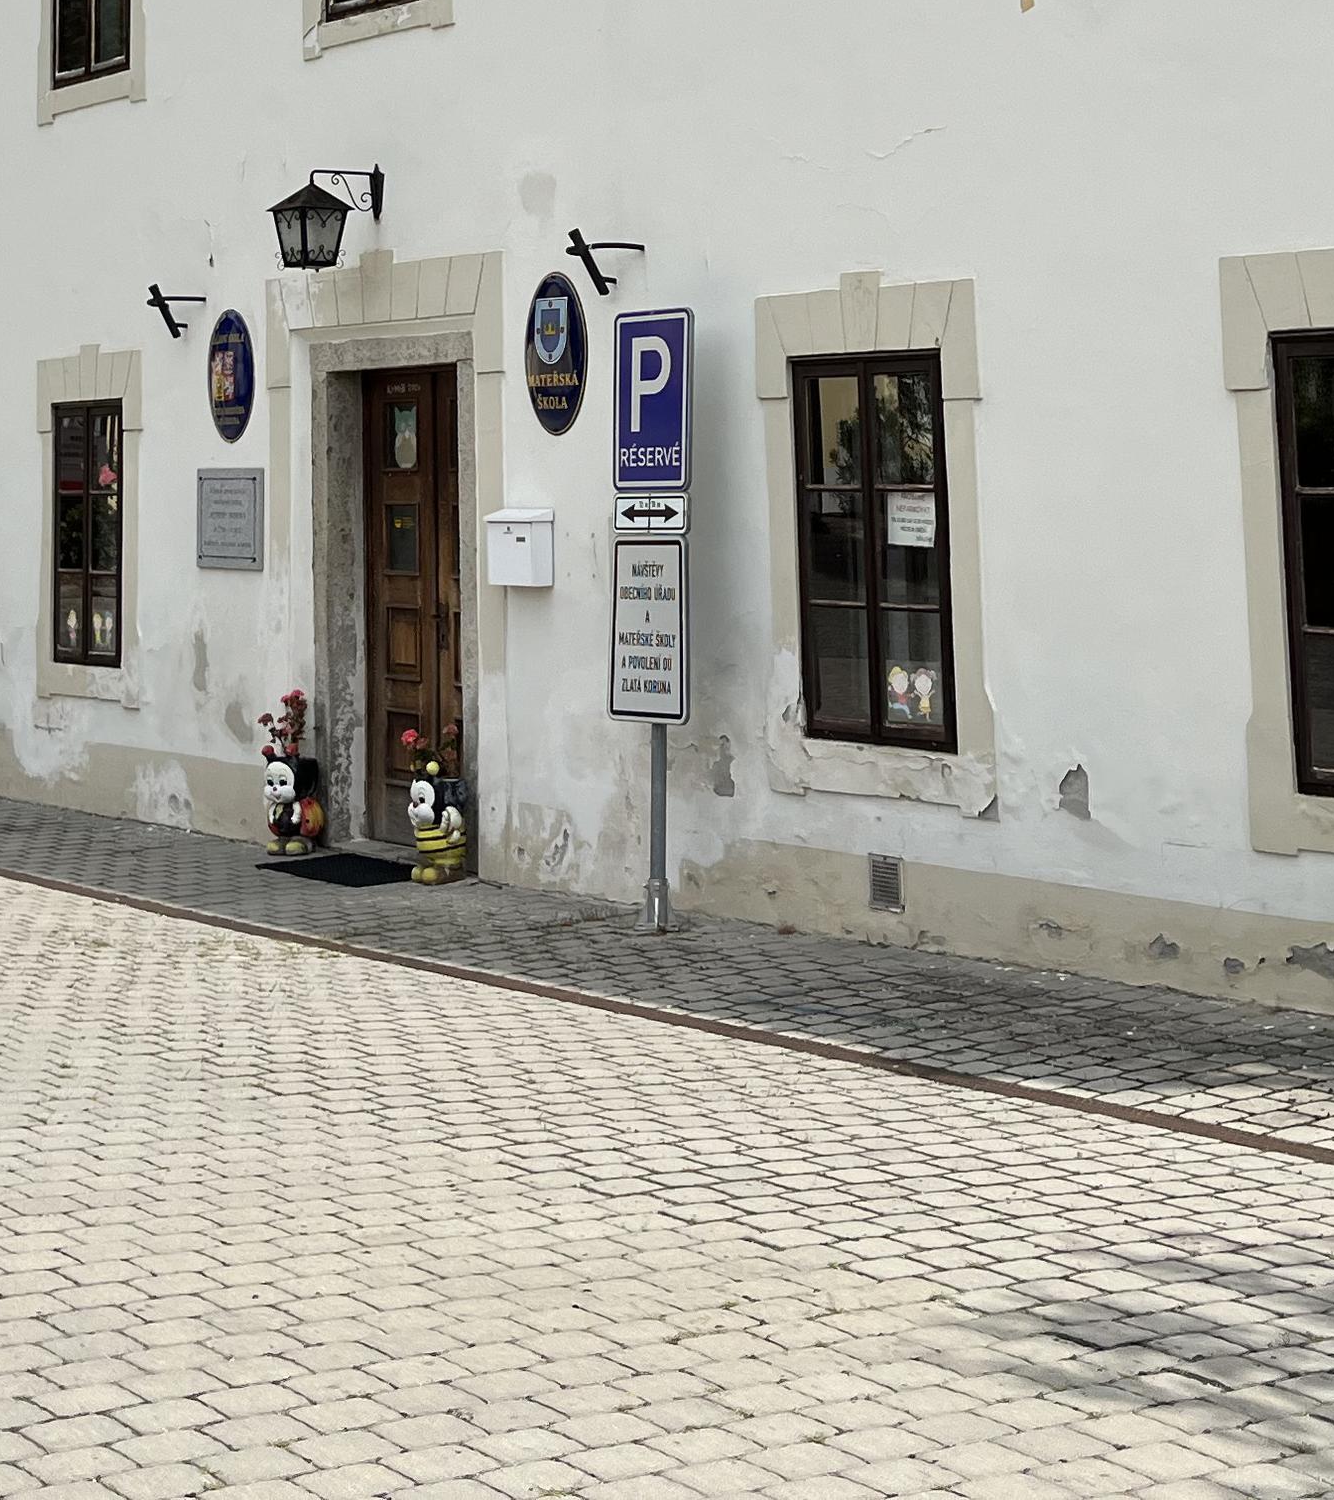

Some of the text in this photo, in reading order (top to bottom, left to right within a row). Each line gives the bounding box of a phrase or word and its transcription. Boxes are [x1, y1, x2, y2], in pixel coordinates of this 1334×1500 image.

[528, 370, 579, 387] MATEŘSKÁ
[630, 335, 671, 433] P
[537, 393, 568, 410] ŠKOLA
[620, 441, 680, 467] RÉSERVÉ
[645, 609, 650, 623] A
[621, 655, 626, 669] A
[621, 676, 672, 694] ZLATÁ KORUNA
